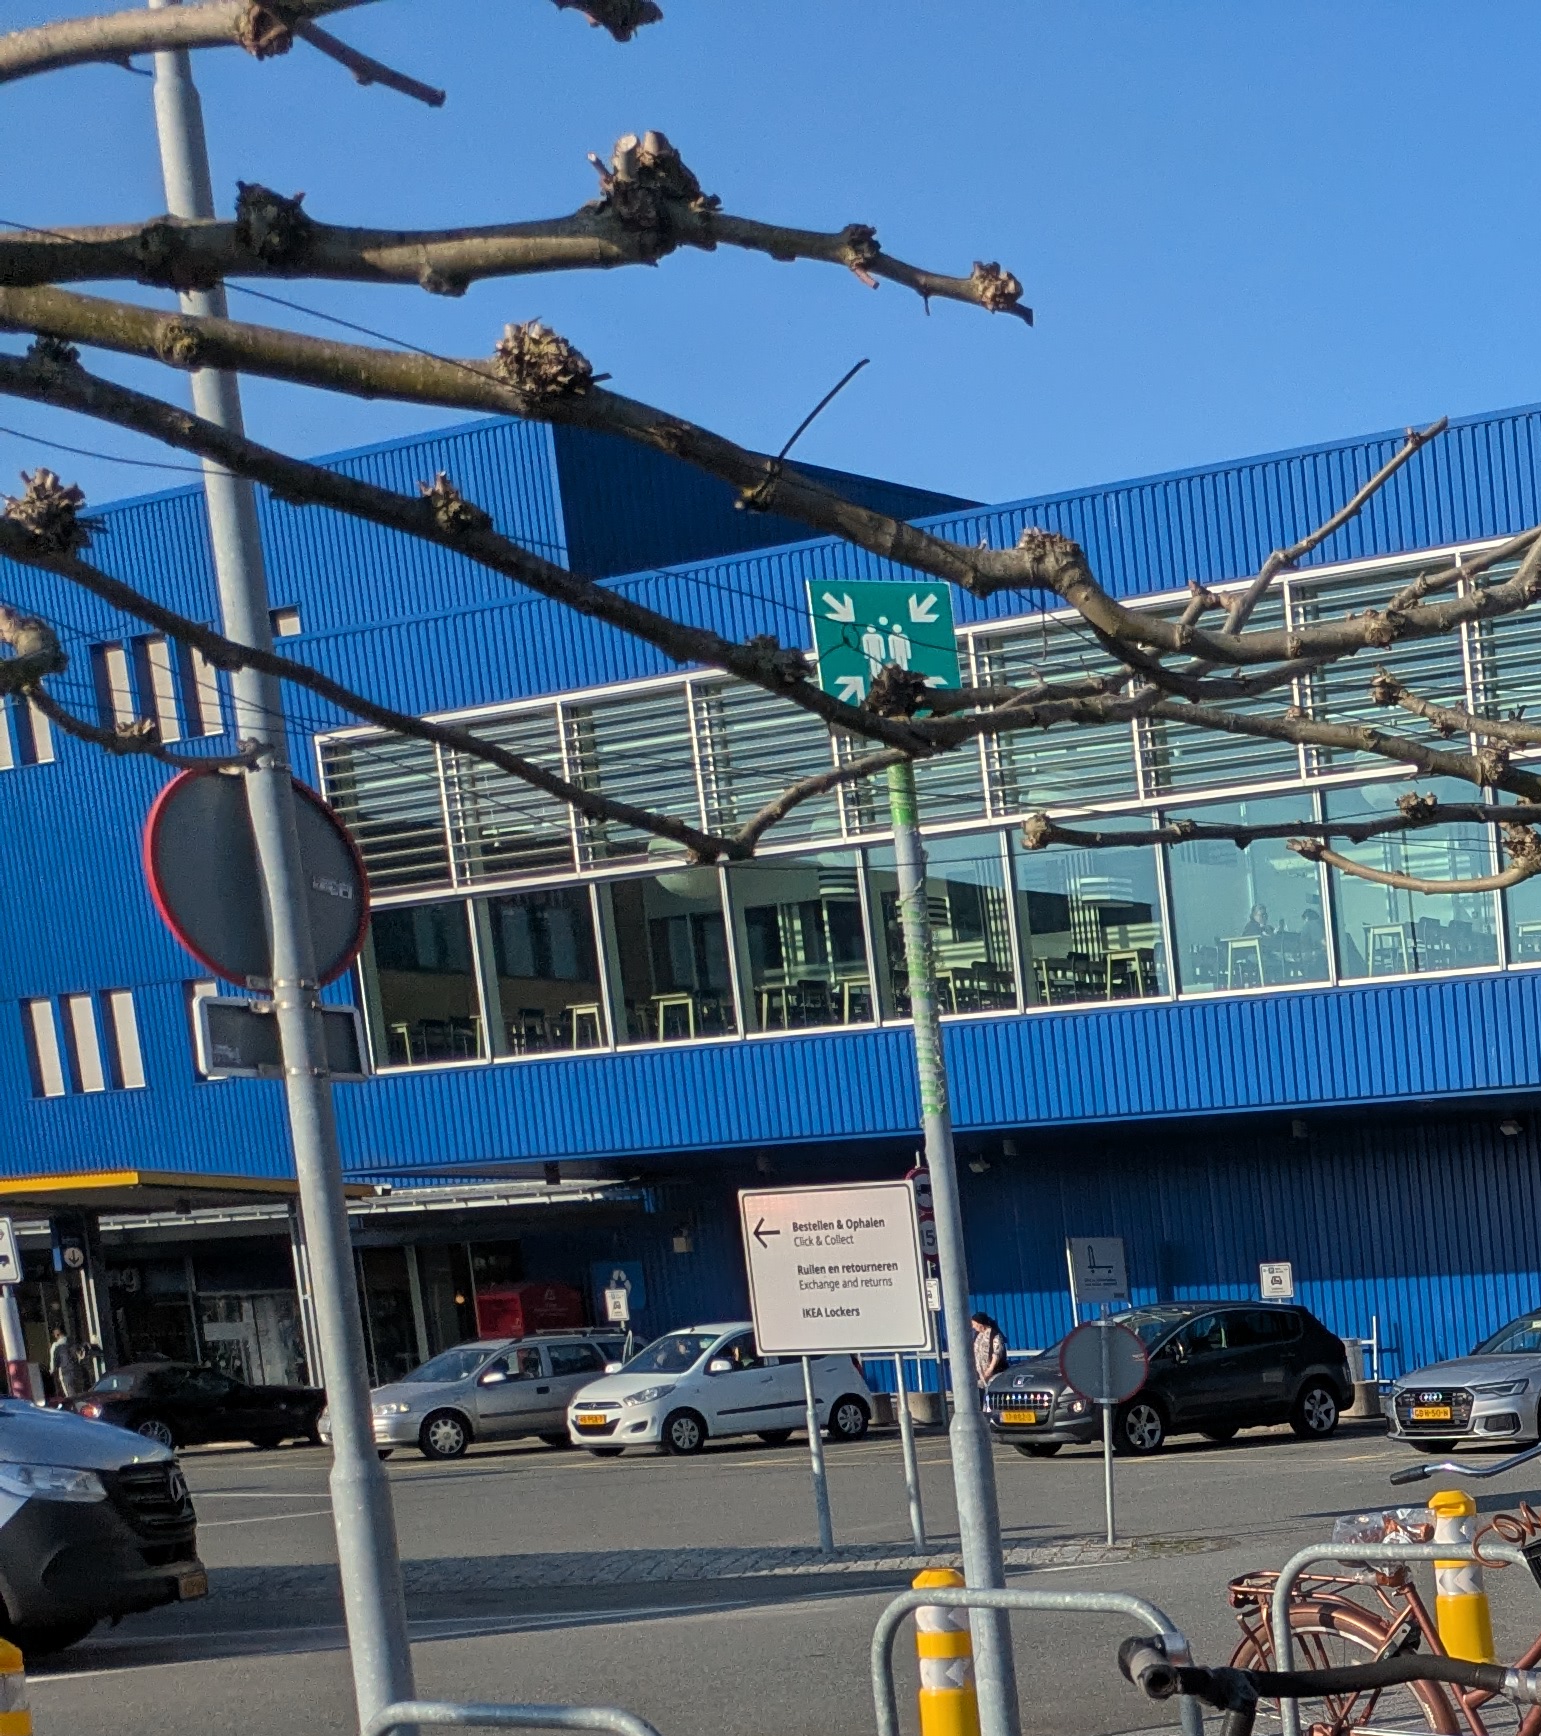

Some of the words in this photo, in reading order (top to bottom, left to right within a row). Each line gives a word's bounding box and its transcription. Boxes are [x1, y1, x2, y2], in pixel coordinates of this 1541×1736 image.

[792, 1220, 834, 1232] Bestellen
[836, 1219, 844, 1230] &
[845, 1217, 885, 1231] Ophalen
[793, 1236, 814, 1247] Click
[815, 1235, 823, 1246] &
[824, 1234, 855, 1246] Collect
[797, 1264, 826, 1275] Ruilen
[828, 1265, 840, 1274] en
[841, 1262, 899, 1273] retourneren
[799, 1279, 840, 1292] Exchange
[842, 1277, 859, 1288] and
[860, 1277, 893, 1288] returns
[802, 1307, 823, 1318] IKEA
[824, 1306, 860, 1317] Lockers
